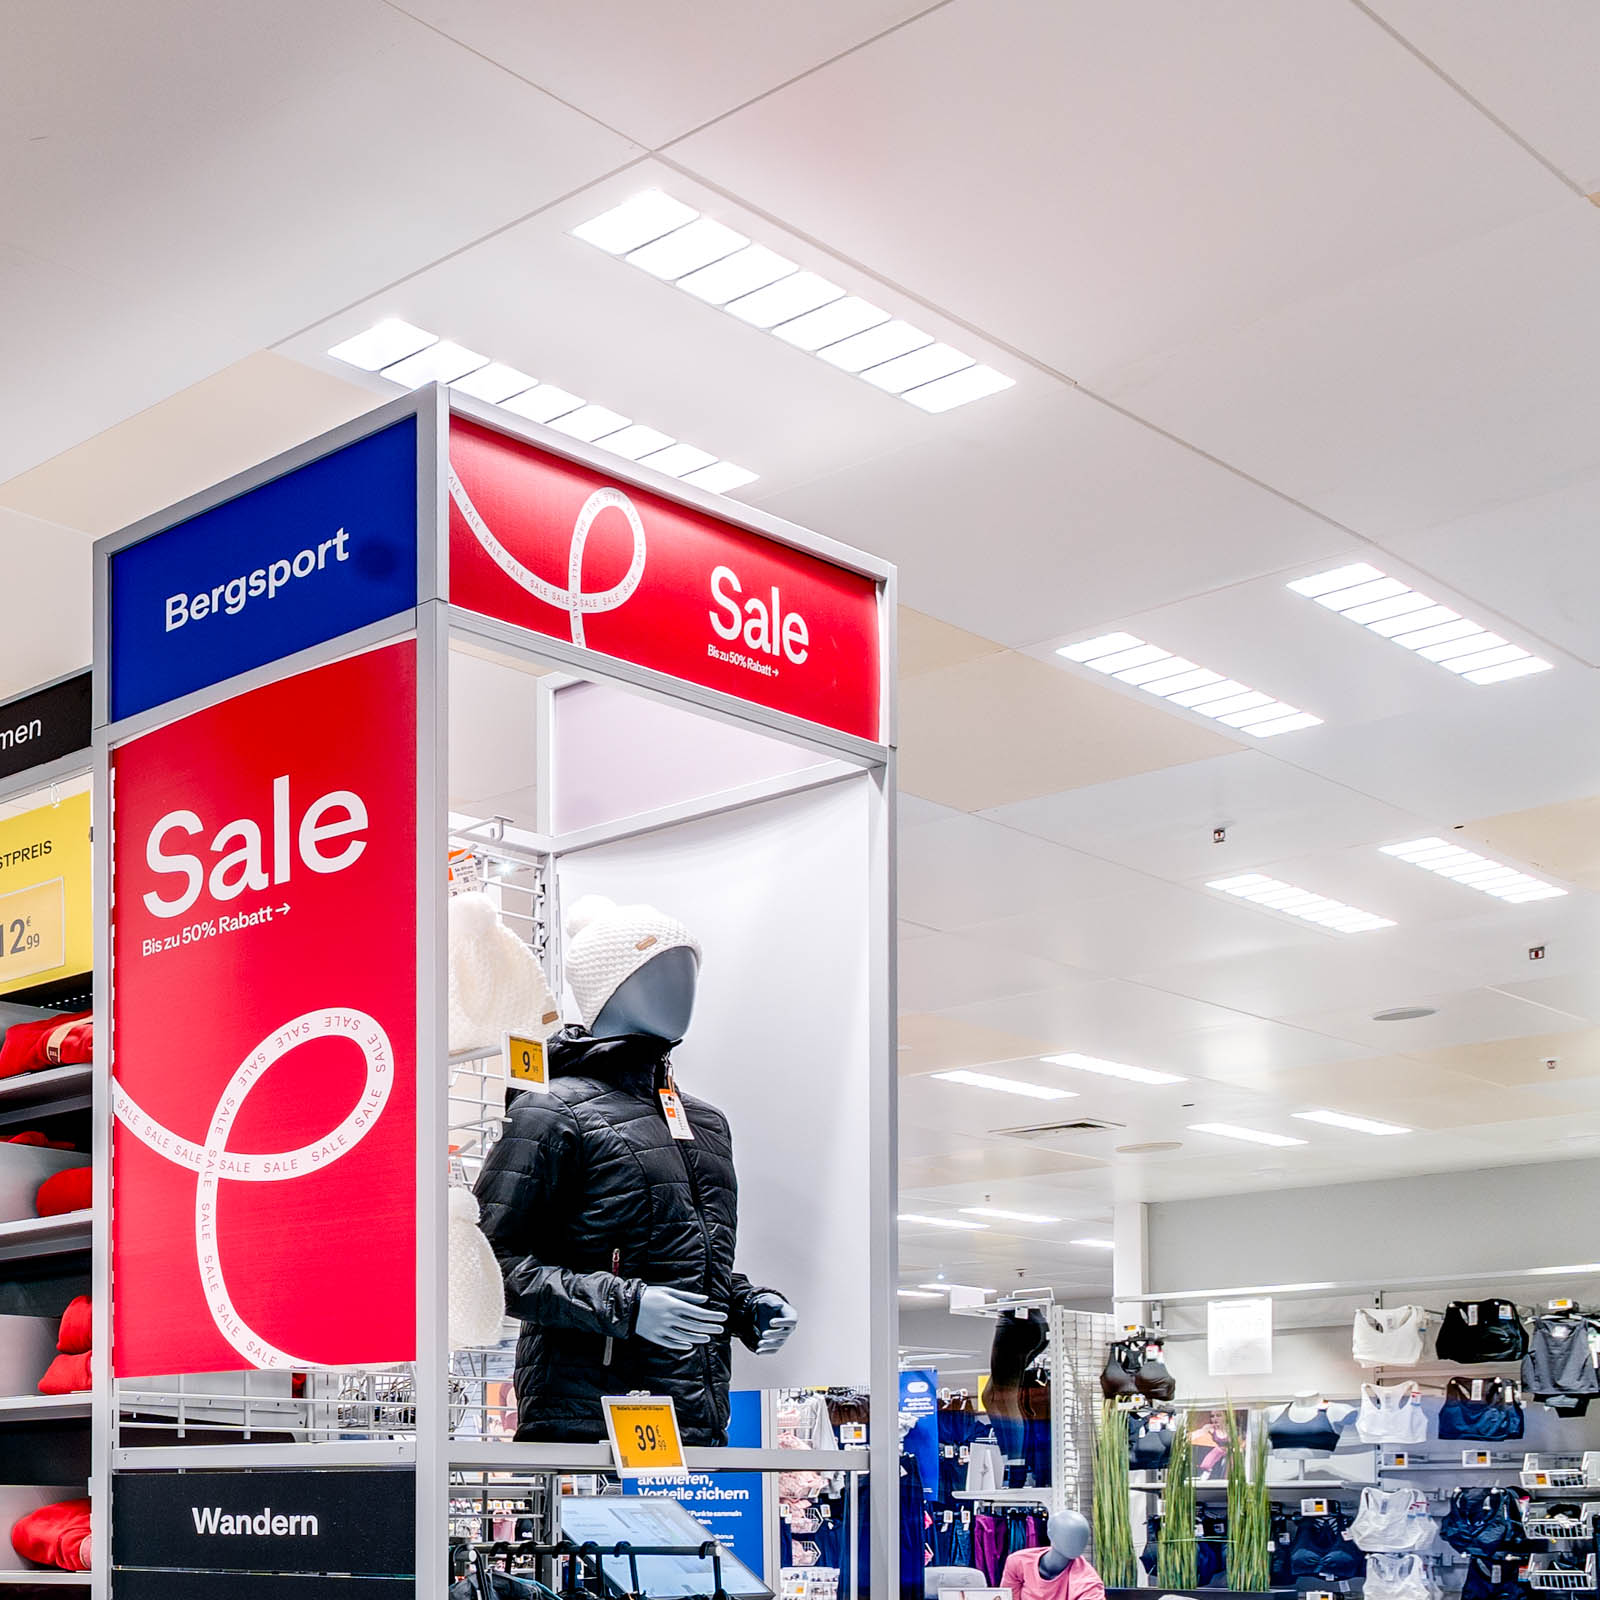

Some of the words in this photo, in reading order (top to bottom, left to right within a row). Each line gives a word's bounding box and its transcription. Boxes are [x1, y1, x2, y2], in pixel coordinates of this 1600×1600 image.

[448, 476, 461, 495] ALE
[463, 503, 480, 530] SALE
[484, 535, 501, 557] SALE
[506, 560, 524, 580] SALE
[530, 579, 548, 596] SALE
[552, 592, 569, 605] SALE
[580, 599, 597, 609] SALE
[603, 592, 620, 607] SALE
[165, 526, 350, 632] Bergsport
[708, 565, 809, 665] Sale
[707, 643, 719, 659] Bis
[719, 651, 729, 662] zu
[729, 651, 747, 668] 50%
[747, 657, 772, 677] Rabatt
[142, 774, 369, 919] Sale
[142, 939, 163, 957] Bis
[163, 933, 181, 950] zu
[181, 919, 217, 945] 50%
[218, 905, 273, 934] Rabatt
[275, 1022, 310, 1049] SALE
[324, 1016, 361, 1031] SALE
[238, 1052, 267, 1087] SALE
[367, 1033, 386, 1073] SALE
[522, 1050, 531, 1073] 9
[117, 1099, 140, 1126] SALE
[214, 1097, 235, 1135] SALE
[354, 1088, 383, 1128] SALE
[144, 1126, 170, 1149] SALE
[174, 1144, 201, 1165] SALE
[311, 1134, 347, 1163] SALE
[203, 1149, 217, 1188] SALE
[219, 1160, 250, 1173] SALE
[263, 1158, 299, 1173] SALE
[201, 1203, 211, 1241] SALE
[204, 1255, 219, 1293] SALE
[217, 1303, 241, 1337] SALE
[246, 1341, 278, 1367] SALE
[695, 1487, 749, 1500] sichern
[192, 1507, 319, 1536] Wandern
